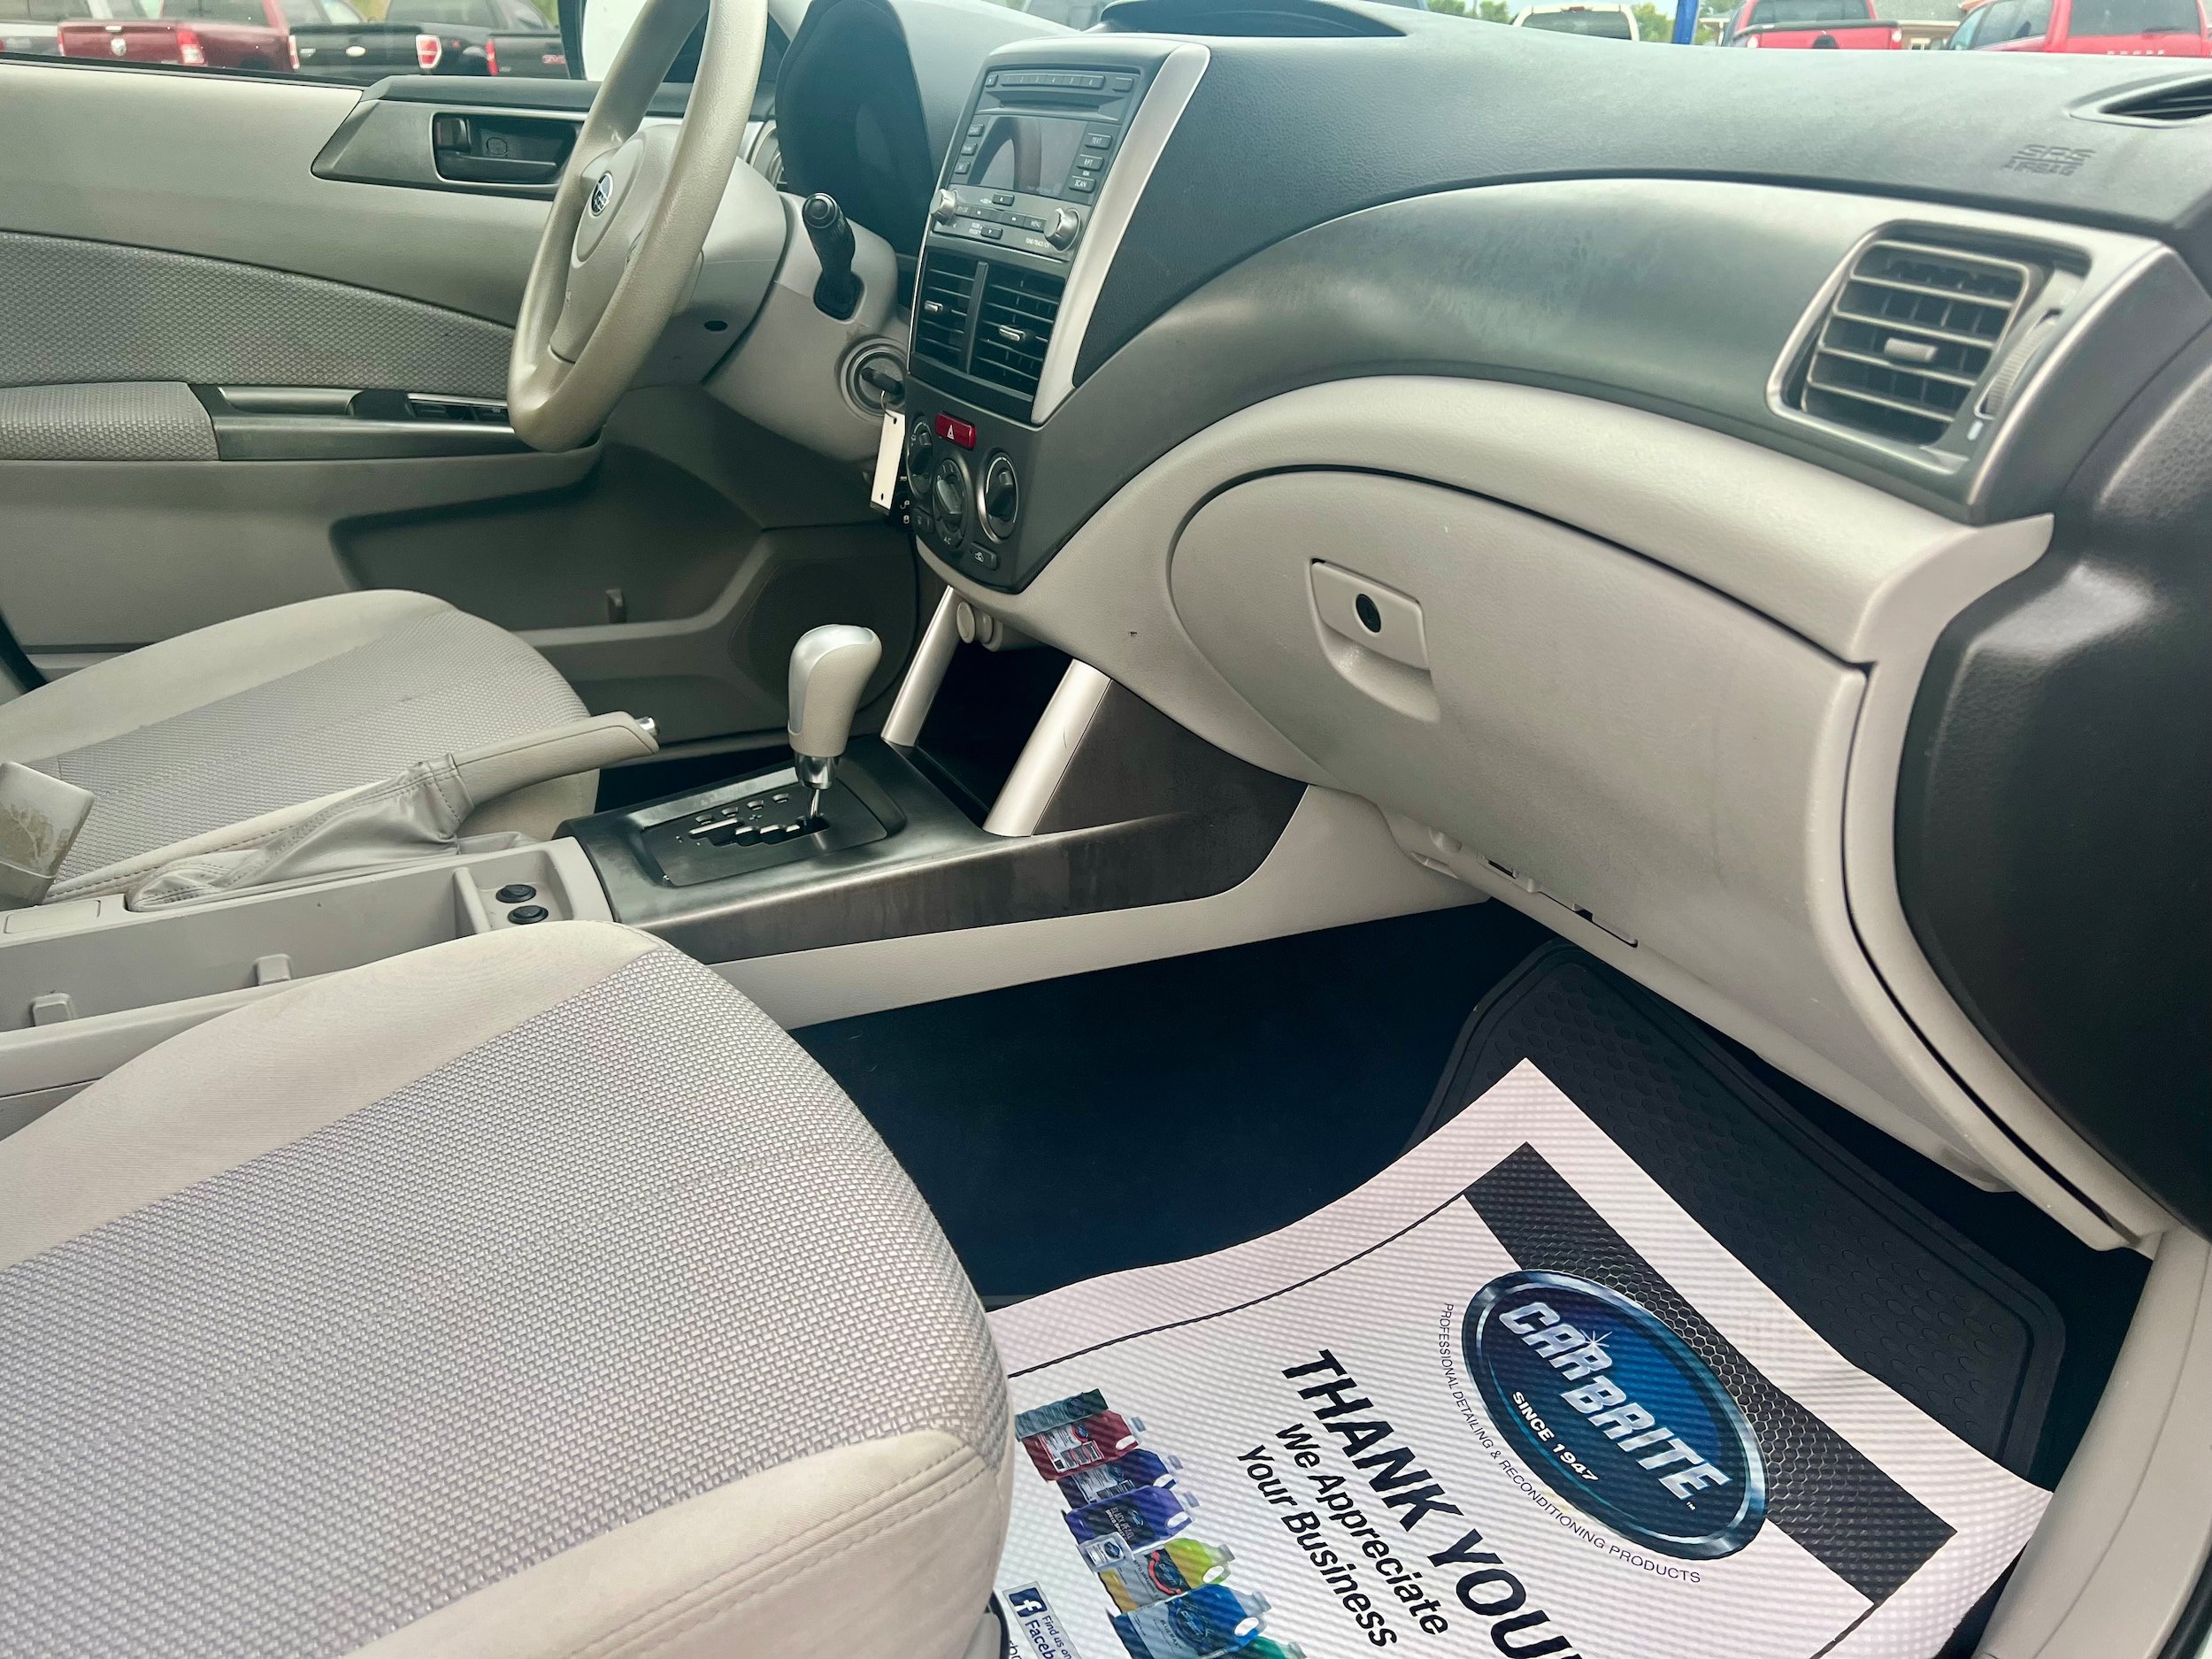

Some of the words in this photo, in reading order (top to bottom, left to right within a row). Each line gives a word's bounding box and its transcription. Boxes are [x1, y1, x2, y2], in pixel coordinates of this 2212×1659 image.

[1074, 179, 1087, 188] SCAN
[2016, 143, 2096, 163] SRS
[1439, 1302, 1459, 1390] PROFESSIONAL
[1452, 1390, 1494, 1449] DETAILING
[1490, 1450, 1502, 1460] &
[1499, 1459, 1606, 1549] RECONDITIONING
[1609, 1544, 1701, 1584] PRODUCTS
[1499, 1302, 1613, 1381] CAR
[1560, 1375, 1732, 1500] BRITE
[1512, 1391, 1555, 1442] SINCE
[1552, 1442, 1599, 1481] 1947
[1236, 1444, 1299, 1506] Your
[1280, 1510, 1398, 1647] Business
[1275, 1423, 1322, 1469] We
[1306, 1474, 1449, 1636] Appreciate
[1280, 1348, 1465, 1532] THANK
[1426, 1528, 1582, 1659] YOU
[1041, 1615, 1060, 1636] Find
[1054, 1637, 1064, 1648] us
